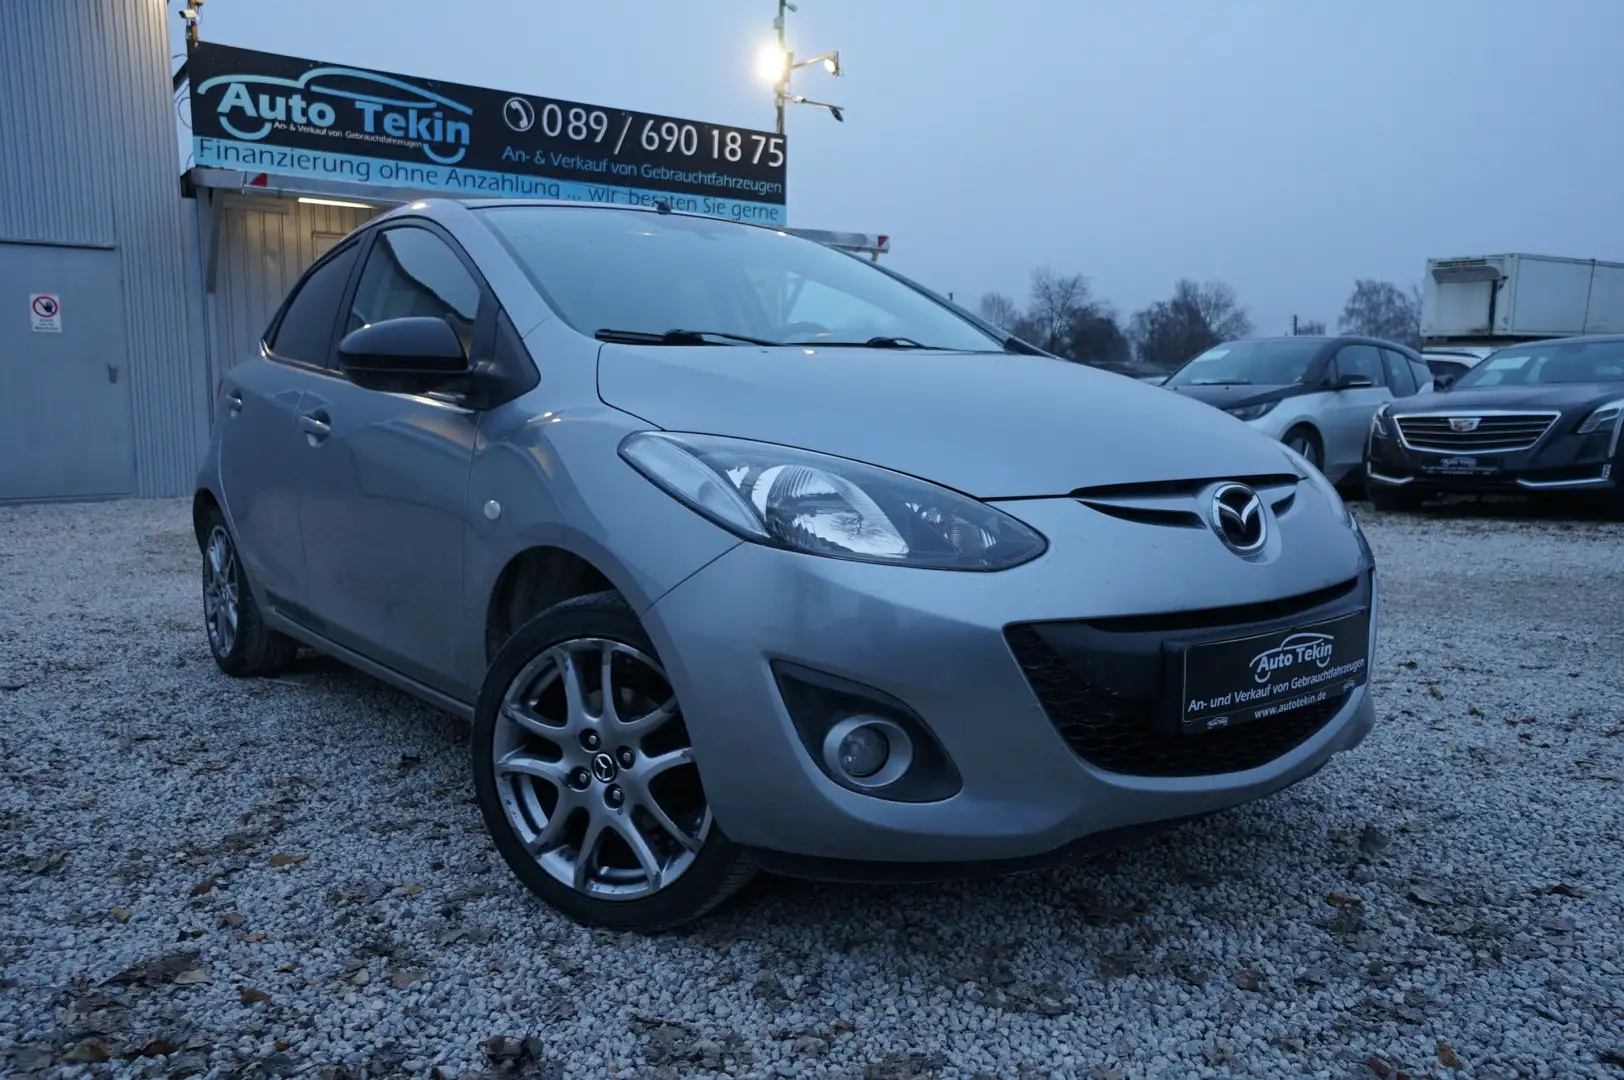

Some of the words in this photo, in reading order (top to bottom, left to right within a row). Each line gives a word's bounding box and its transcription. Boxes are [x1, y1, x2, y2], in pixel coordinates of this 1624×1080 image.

[217, 82, 336, 127] Auto
[355, 100, 470, 145] Tekin
[298, 125, 327, 136] Verkauf
[345, 131, 423, 149] Gebrauchtfahrzeugen
[542, 104, 608, 143] 089
[614, 117, 632, 155] /
[641, 120, 698, 156] 690
[711, 129, 742, 162] 18
[752, 134, 784, 167] 75
[200, 138, 370, 182] Finanzierung
[379, 160, 438, 185] ohne
[445, 169, 560, 199] Anzahlung
[588, 185, 615, 203] wir
[703, 197, 726, 215] Sie
[732, 204, 778, 222] gerne
[502, 146, 530, 163] An-
[535, 150, 545, 164] &
[551, 152, 608, 172] Verkauf
[612, 163, 637, 176] von
[642, 164, 782, 194] Gebrauchtfahrzeugen
[1257, 653, 1293, 672] Auto
[1296, 642, 1332, 663] Tekin
[1188, 699, 1208, 713] An-
[1210, 694, 1231, 708] und
[1234, 684, 1271, 703] Verkauf
[1273, 683, 1289, 694] von
[1291, 658, 1364, 689] Gebrauchtfahrzeugen
[1254, 691, 1326, 719] www.autotekin.de
